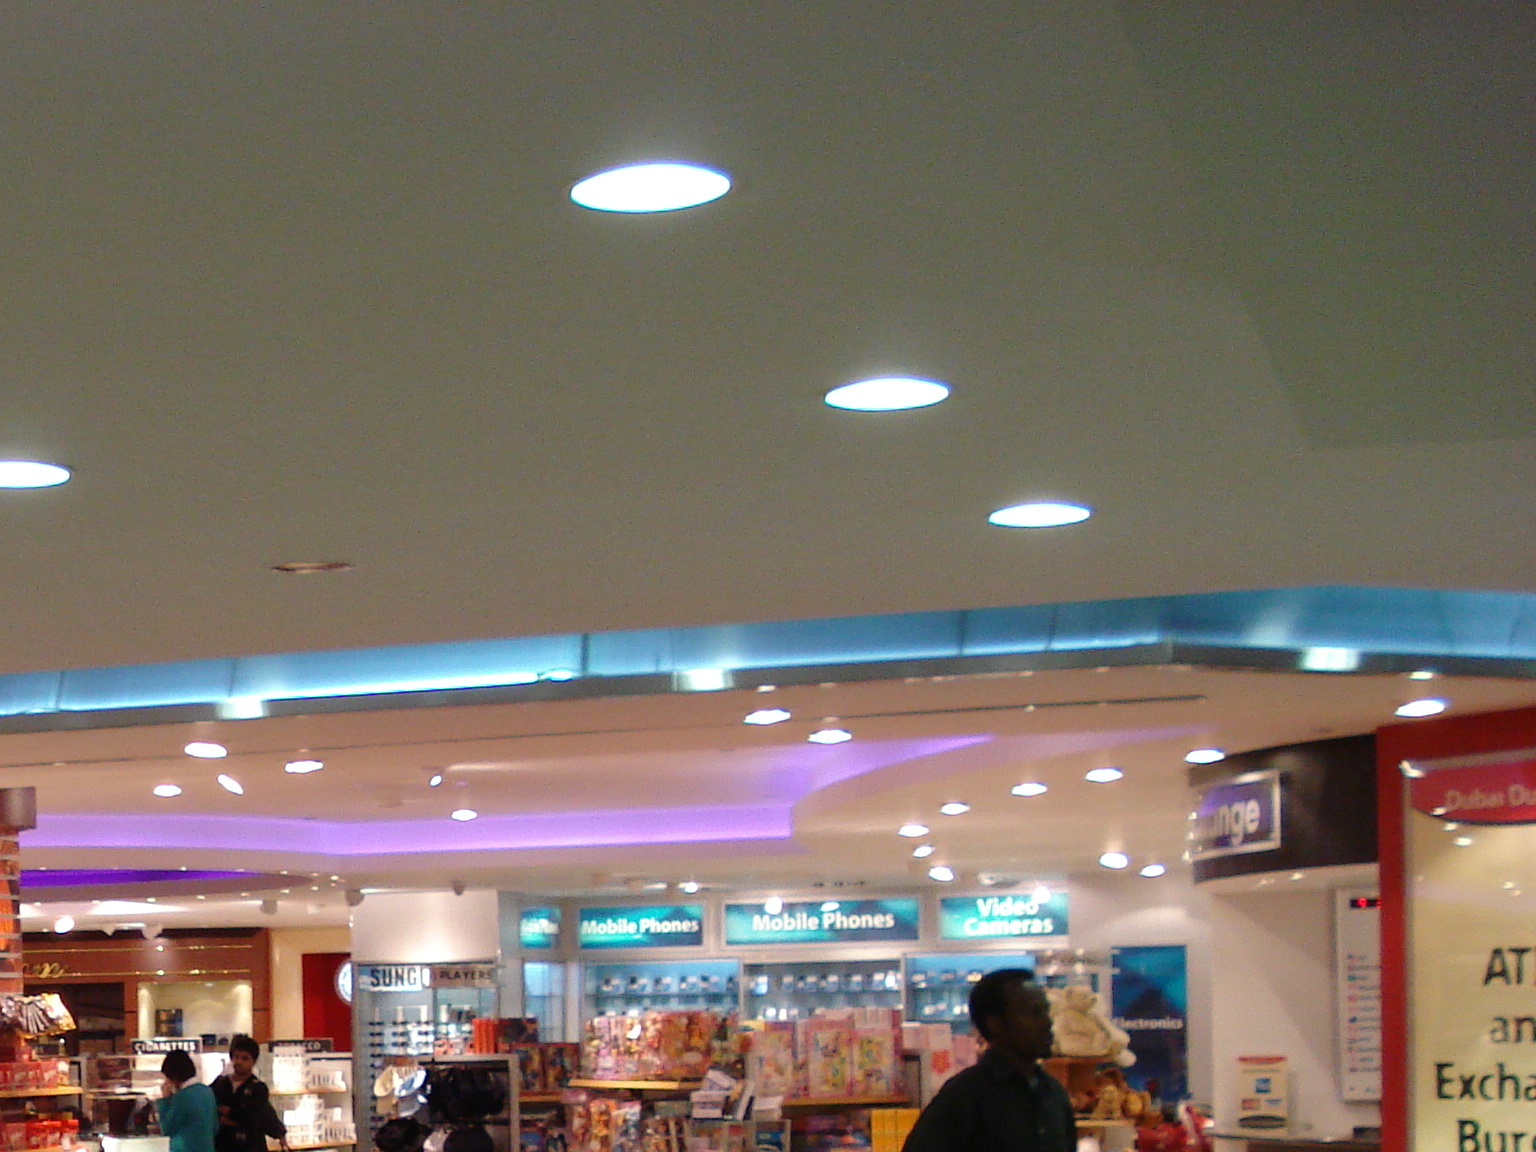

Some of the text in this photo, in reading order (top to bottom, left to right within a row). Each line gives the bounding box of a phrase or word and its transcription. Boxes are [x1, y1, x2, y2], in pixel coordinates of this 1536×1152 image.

[977, 898, 1039, 917] Video
[581, 917, 699, 934] Mobile Phones
[753, 911, 895, 931] Mobile Phones
[964, 918, 1054, 935] Cameras
[1483, 948, 1536, 985] AT
